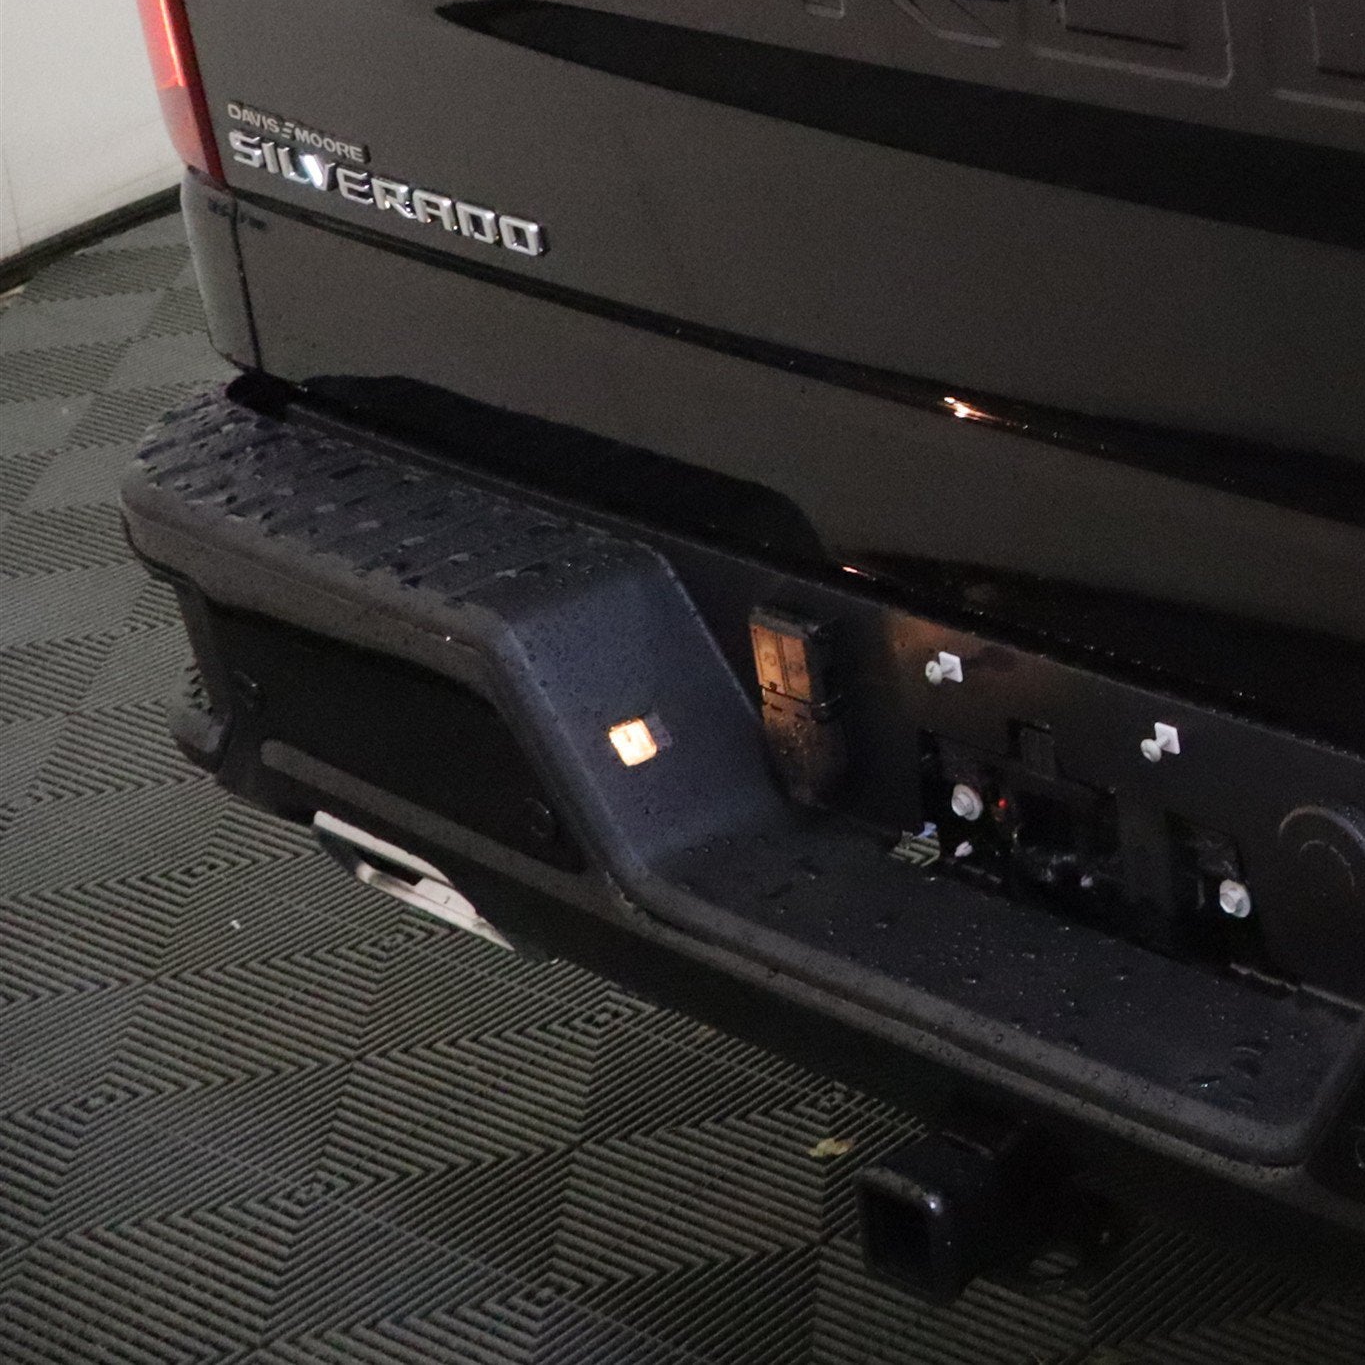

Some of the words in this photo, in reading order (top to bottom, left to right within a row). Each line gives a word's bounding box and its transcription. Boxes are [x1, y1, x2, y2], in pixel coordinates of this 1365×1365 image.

[227, 101, 279, 135] DAVIS
[294, 127, 365, 165] MOORE
[228, 130, 546, 256] SILVERADO
